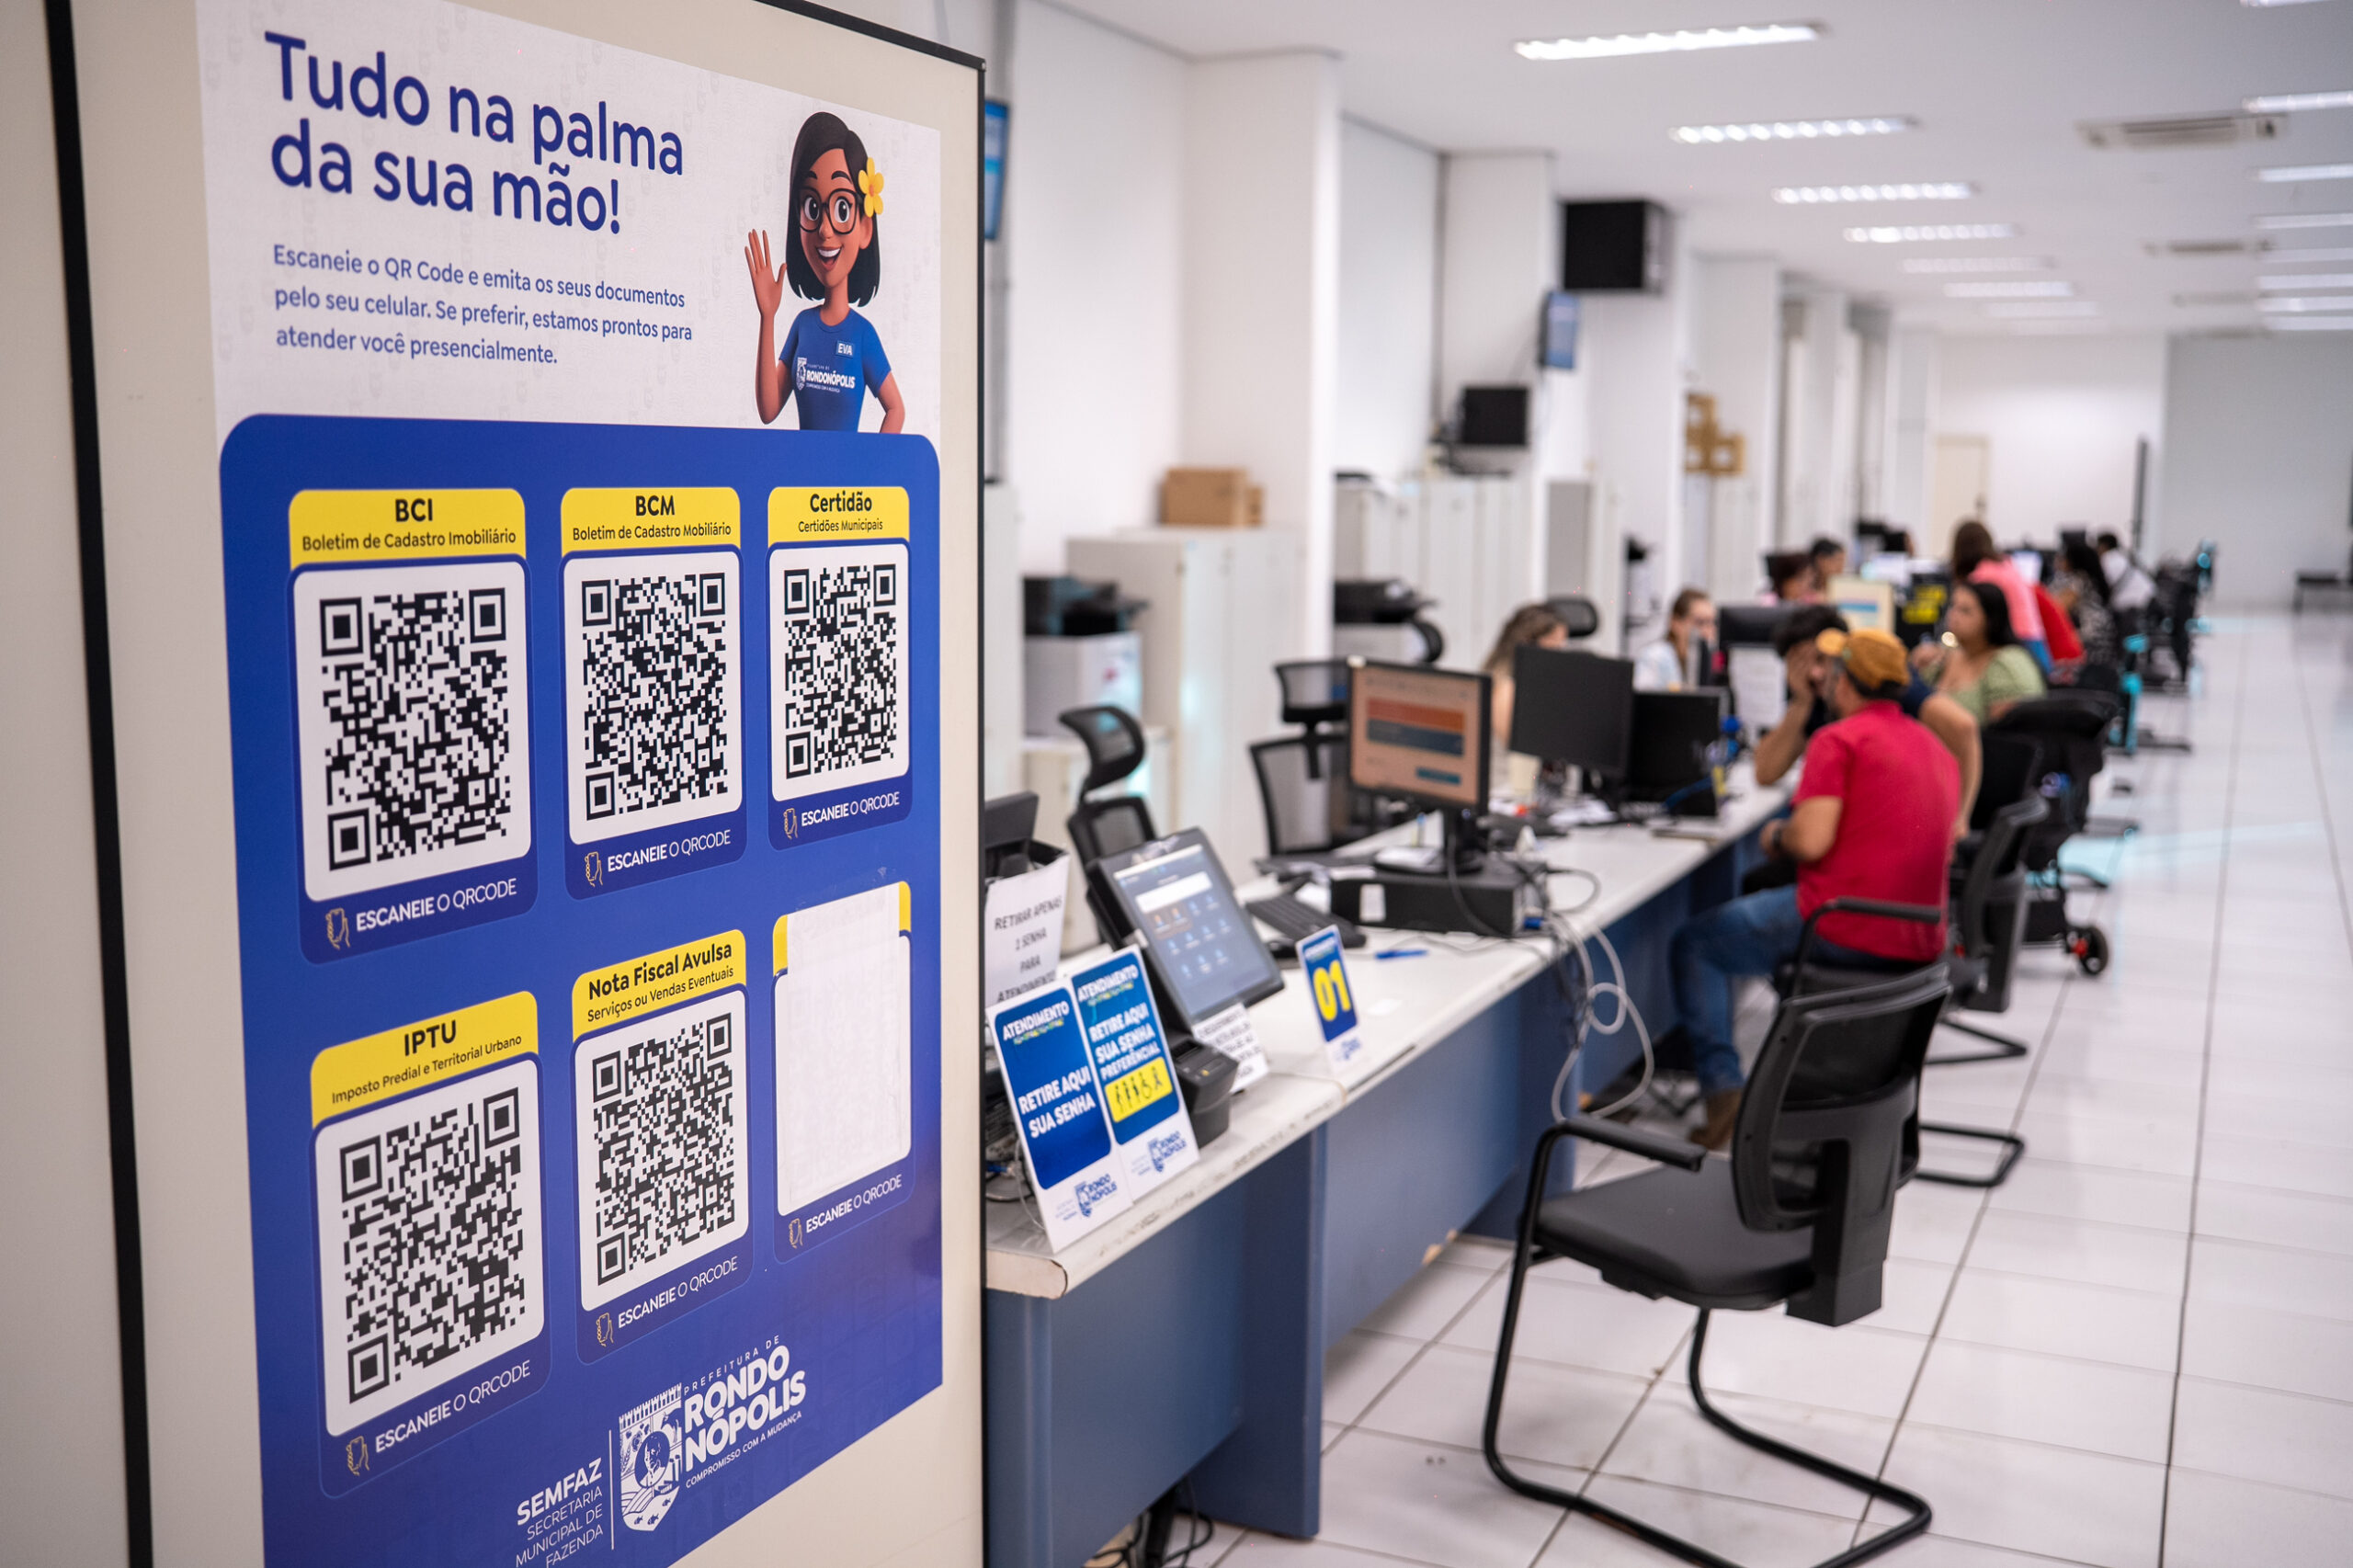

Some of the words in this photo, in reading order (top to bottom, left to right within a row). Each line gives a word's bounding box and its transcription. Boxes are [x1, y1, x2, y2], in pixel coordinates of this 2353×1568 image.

[265, 30, 430, 127] Tudo
[449, 85, 514, 143] na
[533, 100, 683, 176] palma
[271, 118, 353, 195] da
[373, 151, 473, 212] sua
[493, 161, 620, 234] mão!
[274, 244, 362, 275] Escaneie
[368, 259, 380, 276] o
[384, 257, 412, 280] QR
[417, 261, 464, 285] Code
[468, 270, 479, 286] e
[483, 268, 531, 291] emita
[535, 278, 553, 294] os
[557, 278, 592, 298] seus
[595, 280, 685, 308] documentos
[275, 285, 320, 311] pelo
[325, 293, 359, 312] seu
[364, 294, 431, 319] celular.
[436, 301, 458, 320] Se
[461, 303, 529, 331] preferir,
[532, 310, 598, 333] estamos
[602, 318, 658, 338] prontos
[662, 324, 692, 343] para
[276, 325, 357, 351] atender
[360, 332, 405, 355] você
[410, 337, 558, 364] presencialmente.
[837, 343, 853, 356] EVA
[806, 370, 856, 389] RONDONÓPOLIS
[394, 498, 434, 523] BCI
[635, 494, 676, 517] BCM
[798, 517, 839, 533] Certidões
[841, 518, 883, 533] Municipais
[810, 490, 872, 513] Certidão
[302, 534, 359, 551] Boletim
[362, 532, 381, 549] de
[384, 531, 446, 548] Cadastro
[449, 527, 517, 546] Imobiliário
[573, 526, 615, 540] Boletim
[618, 524, 632, 539] de
[634, 523, 681, 539] Cadastro
[683, 522, 732, 537] Mobiliário
[801, 803, 849, 826] ESCANEIE
[850, 801, 858, 815] O
[859, 791, 901, 812] QRCODE
[608, 844, 667, 872] ESCANEIE
[669, 841, 680, 858] O
[681, 829, 732, 856] QRCODE
[356, 896, 435, 932] ESCANEIE
[437, 892, 450, 913] O
[452, 878, 517, 910] QRCODE
[587, 996, 632, 1023] Serviços
[634, 994, 648, 1007] ou
[649, 981, 687, 1002] Vendas
[688, 965, 733, 990] Eventuais
[588, 972, 630, 1000] Nota
[633, 955, 679, 985] Fiscal
[682, 943, 733, 972] Avulsa
[1077, 964, 1139, 1003] ATENDIMENTO
[1313, 960, 1352, 1021] 01
[404, 1019, 457, 1057] IPTU
[1003, 1001, 1070, 1040] ATENDIMENTO
[1088, 1013, 1125, 1043] RETIRE
[1123, 1002, 1150, 1028] AQUI
[1095, 1040, 1120, 1064] SUA
[1117, 1022, 1156, 1052] SENHA
[331, 1078, 381, 1105] Imposto
[382, 1065, 422, 1089] Predial
[424, 1063, 430, 1074] e
[432, 1045, 483, 1073] Territorial
[485, 1035, 523, 1055] Urbano
[1017, 1079, 1063, 1115] RETIRE
[1061, 1065, 1092, 1095] AQUI
[1029, 1112, 1057, 1139] SUA
[1054, 1092, 1097, 1126] SENHA
[806, 1204, 852, 1233] ESCANEIE
[853, 1197, 862, 1210] O
[862, 1174, 903, 1203] QRCODE
[618, 1287, 676, 1329] ESCANEIE
[677, 1282, 688, 1298] O
[689, 1256, 738, 1292] QRCODE
[684, 1347, 759, 1396] PREFEITURA
[766, 1335, 779, 1350] DE
[685, 1345, 790, 1434] RONDO
[375, 1400, 451, 1453] ESCANEIE
[453, 1393, 466, 1412] O
[469, 1359, 531, 1404] QRCODE
[685, 1369, 807, 1472] NÓPOLIS
[686, 1449, 741, 1489] COMPROMISSO
[743, 1437, 759, 1454] COM
[760, 1432, 767, 1443] A
[767, 1410, 802, 1439] MUDANÇA
[517, 1457, 602, 1527] SEMFAZ
[527, 1485, 603, 1541] SECRETARIA
[516, 1517, 584, 1568] MUNICIPAL
[585, 1503, 603, 1525] DE
[546, 1524, 604, 1568] FAZENDA
